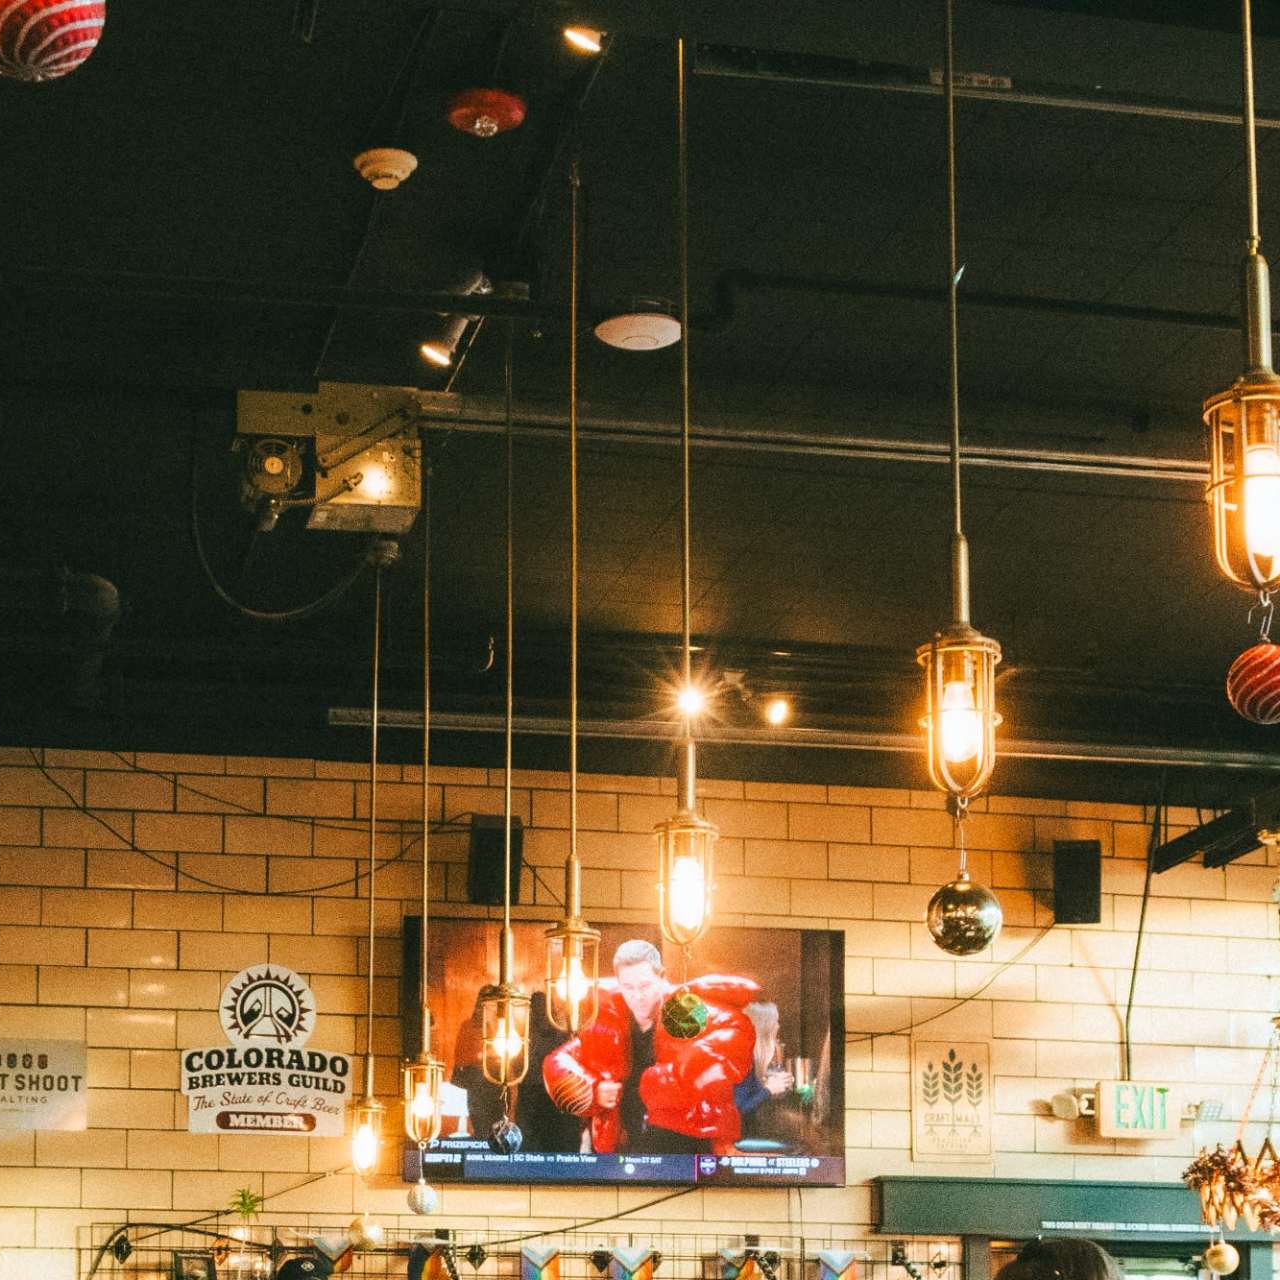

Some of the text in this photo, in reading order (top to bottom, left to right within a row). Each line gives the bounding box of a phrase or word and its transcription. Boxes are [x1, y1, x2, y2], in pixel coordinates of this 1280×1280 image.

[185, 1048, 349, 1077] COLORADO
[15, 1074, 82, 1091] SHOOT
[188, 1072, 346, 1094] BREWERS GUILD
[192, 1090, 340, 1115] The State of Craft Beer
[1116, 1085, 1168, 1129] EXIT
[229, 1113, 304, 1129] MEMBER
